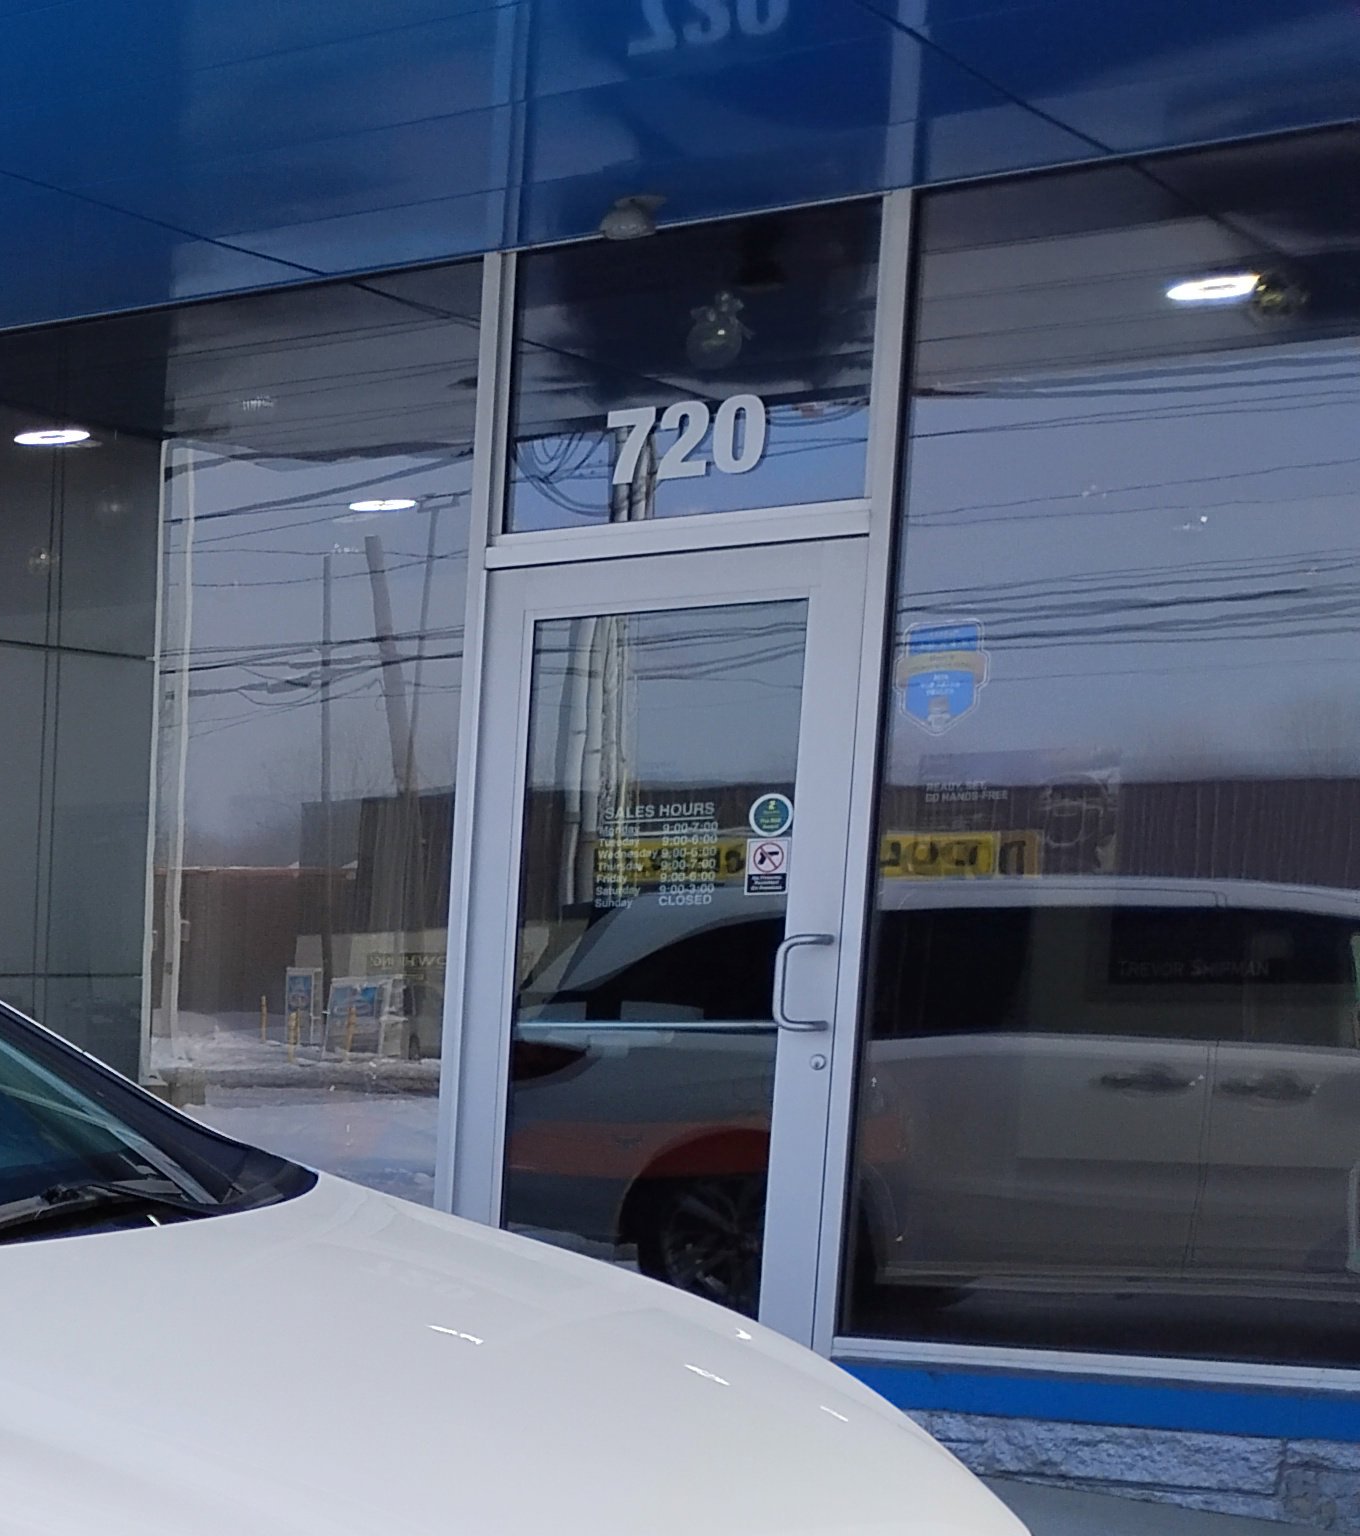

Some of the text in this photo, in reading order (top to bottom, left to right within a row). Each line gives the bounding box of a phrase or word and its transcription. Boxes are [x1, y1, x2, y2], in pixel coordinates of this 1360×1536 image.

[607, 394, 766, 485] 720
[605, 802, 715, 819] SALES HOURS
[599, 839, 640, 848] Tuesday
[598, 849, 659, 859] Wednesday
[598, 861, 644, 872] Thursday
[596, 874, 628, 884] Friday
[595, 886, 641, 897] Saturday
[594, 894, 712, 909] Sunday CLOSED
